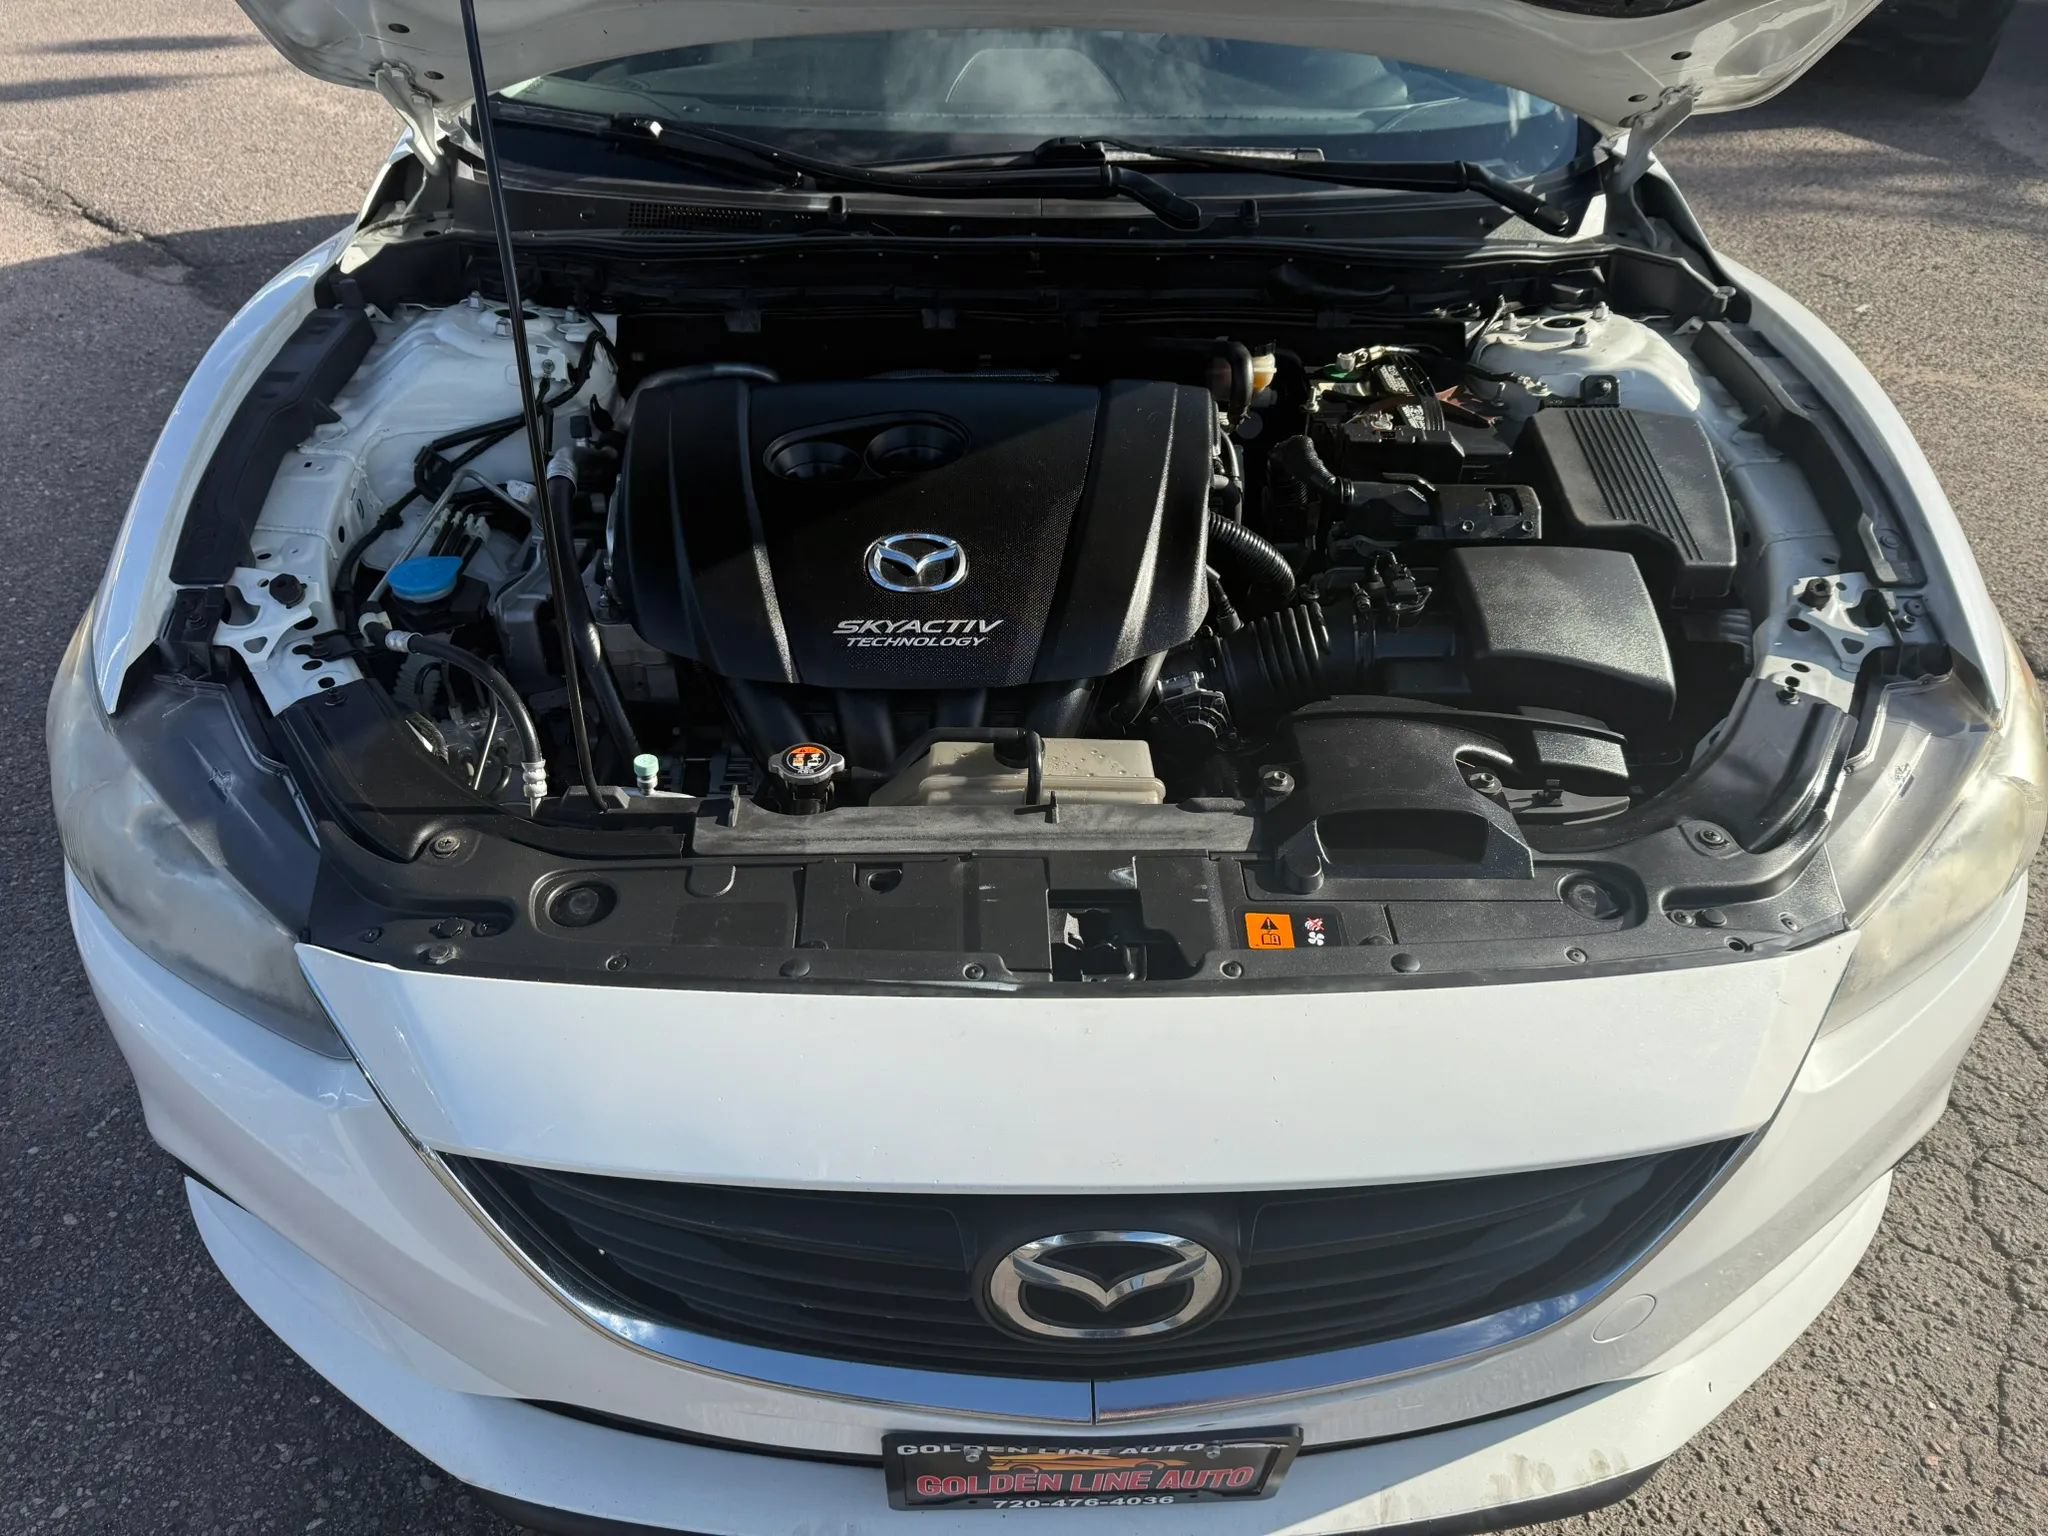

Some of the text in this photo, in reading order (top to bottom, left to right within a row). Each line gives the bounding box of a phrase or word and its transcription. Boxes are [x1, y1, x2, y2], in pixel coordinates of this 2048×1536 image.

[833, 619, 1004, 634] SKYACTIV
[846, 637, 988, 647] TECHNOLOGY
[1039, 1446, 1112, 1456] LINE
[1119, 1443, 1204, 1455] AUTO
[916, 1466, 1255, 1496] GOLDEN LINE AUTO
[993, 1496, 1175, 1509] 720-476-4036
